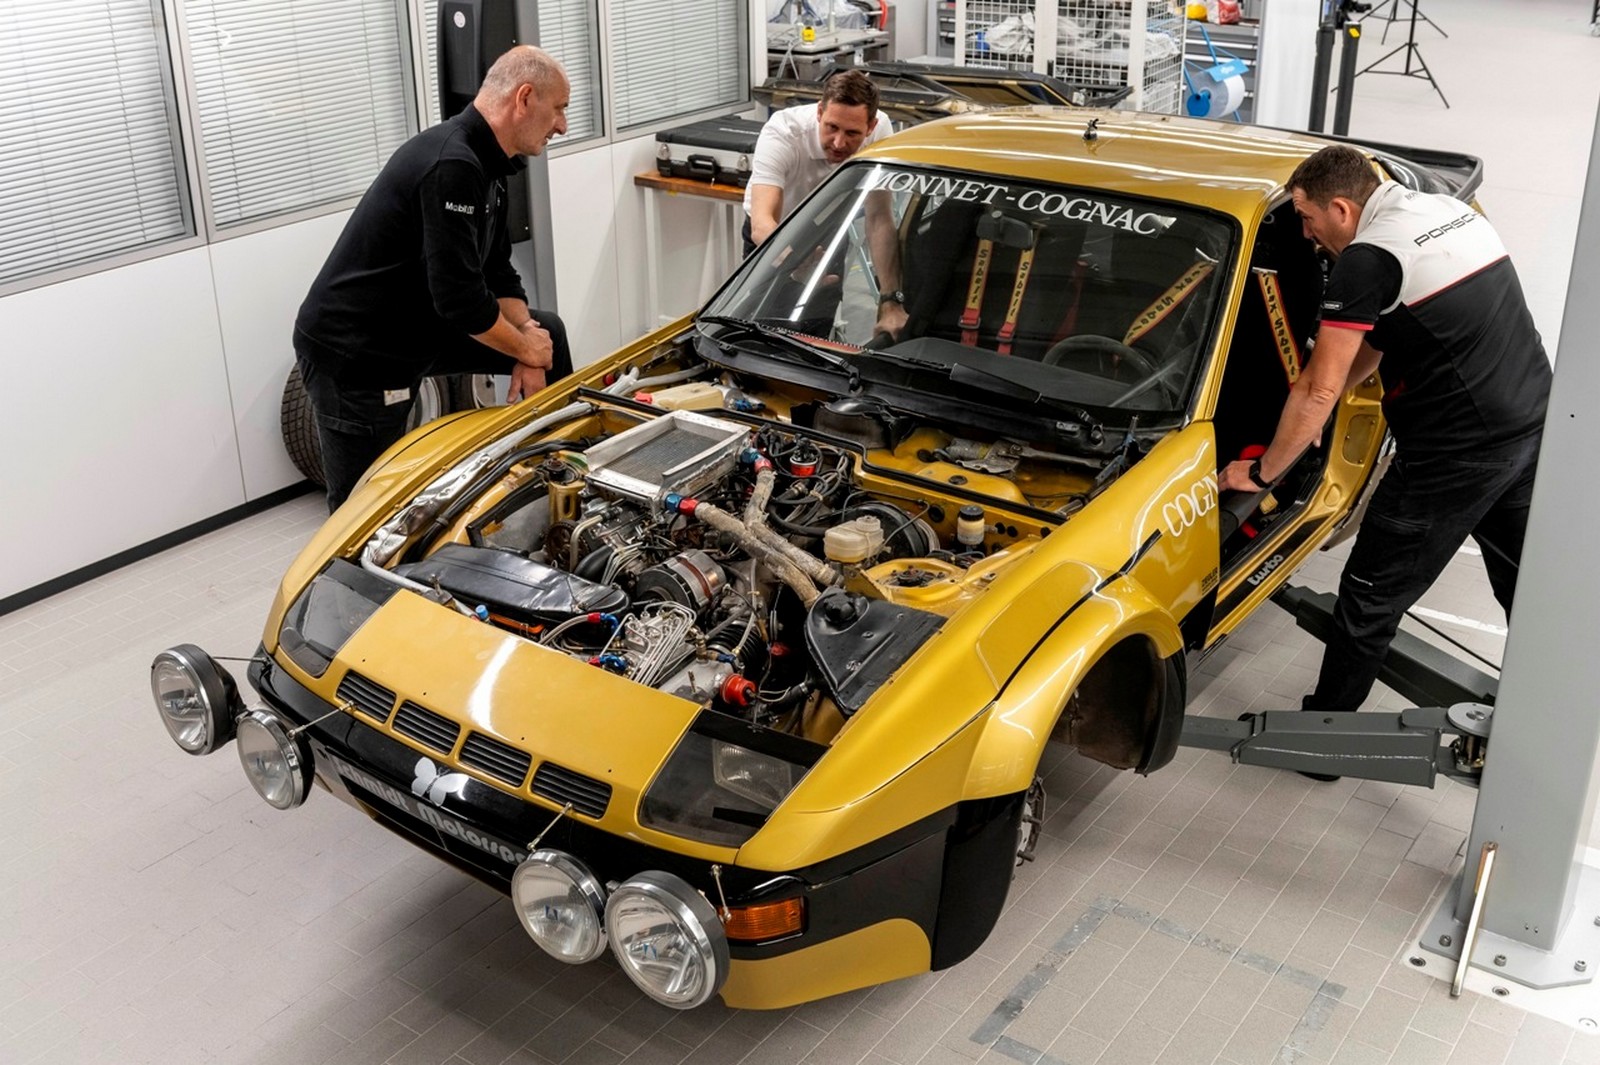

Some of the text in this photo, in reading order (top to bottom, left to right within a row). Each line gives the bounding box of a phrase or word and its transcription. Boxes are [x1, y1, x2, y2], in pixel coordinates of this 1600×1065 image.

[968, 249, 989, 303] Sabelt
[1010, 261, 1031, 316] Sabelt
[1275, 317, 1296, 376] Sabelt
[1246, 554, 1284, 586] turbo
